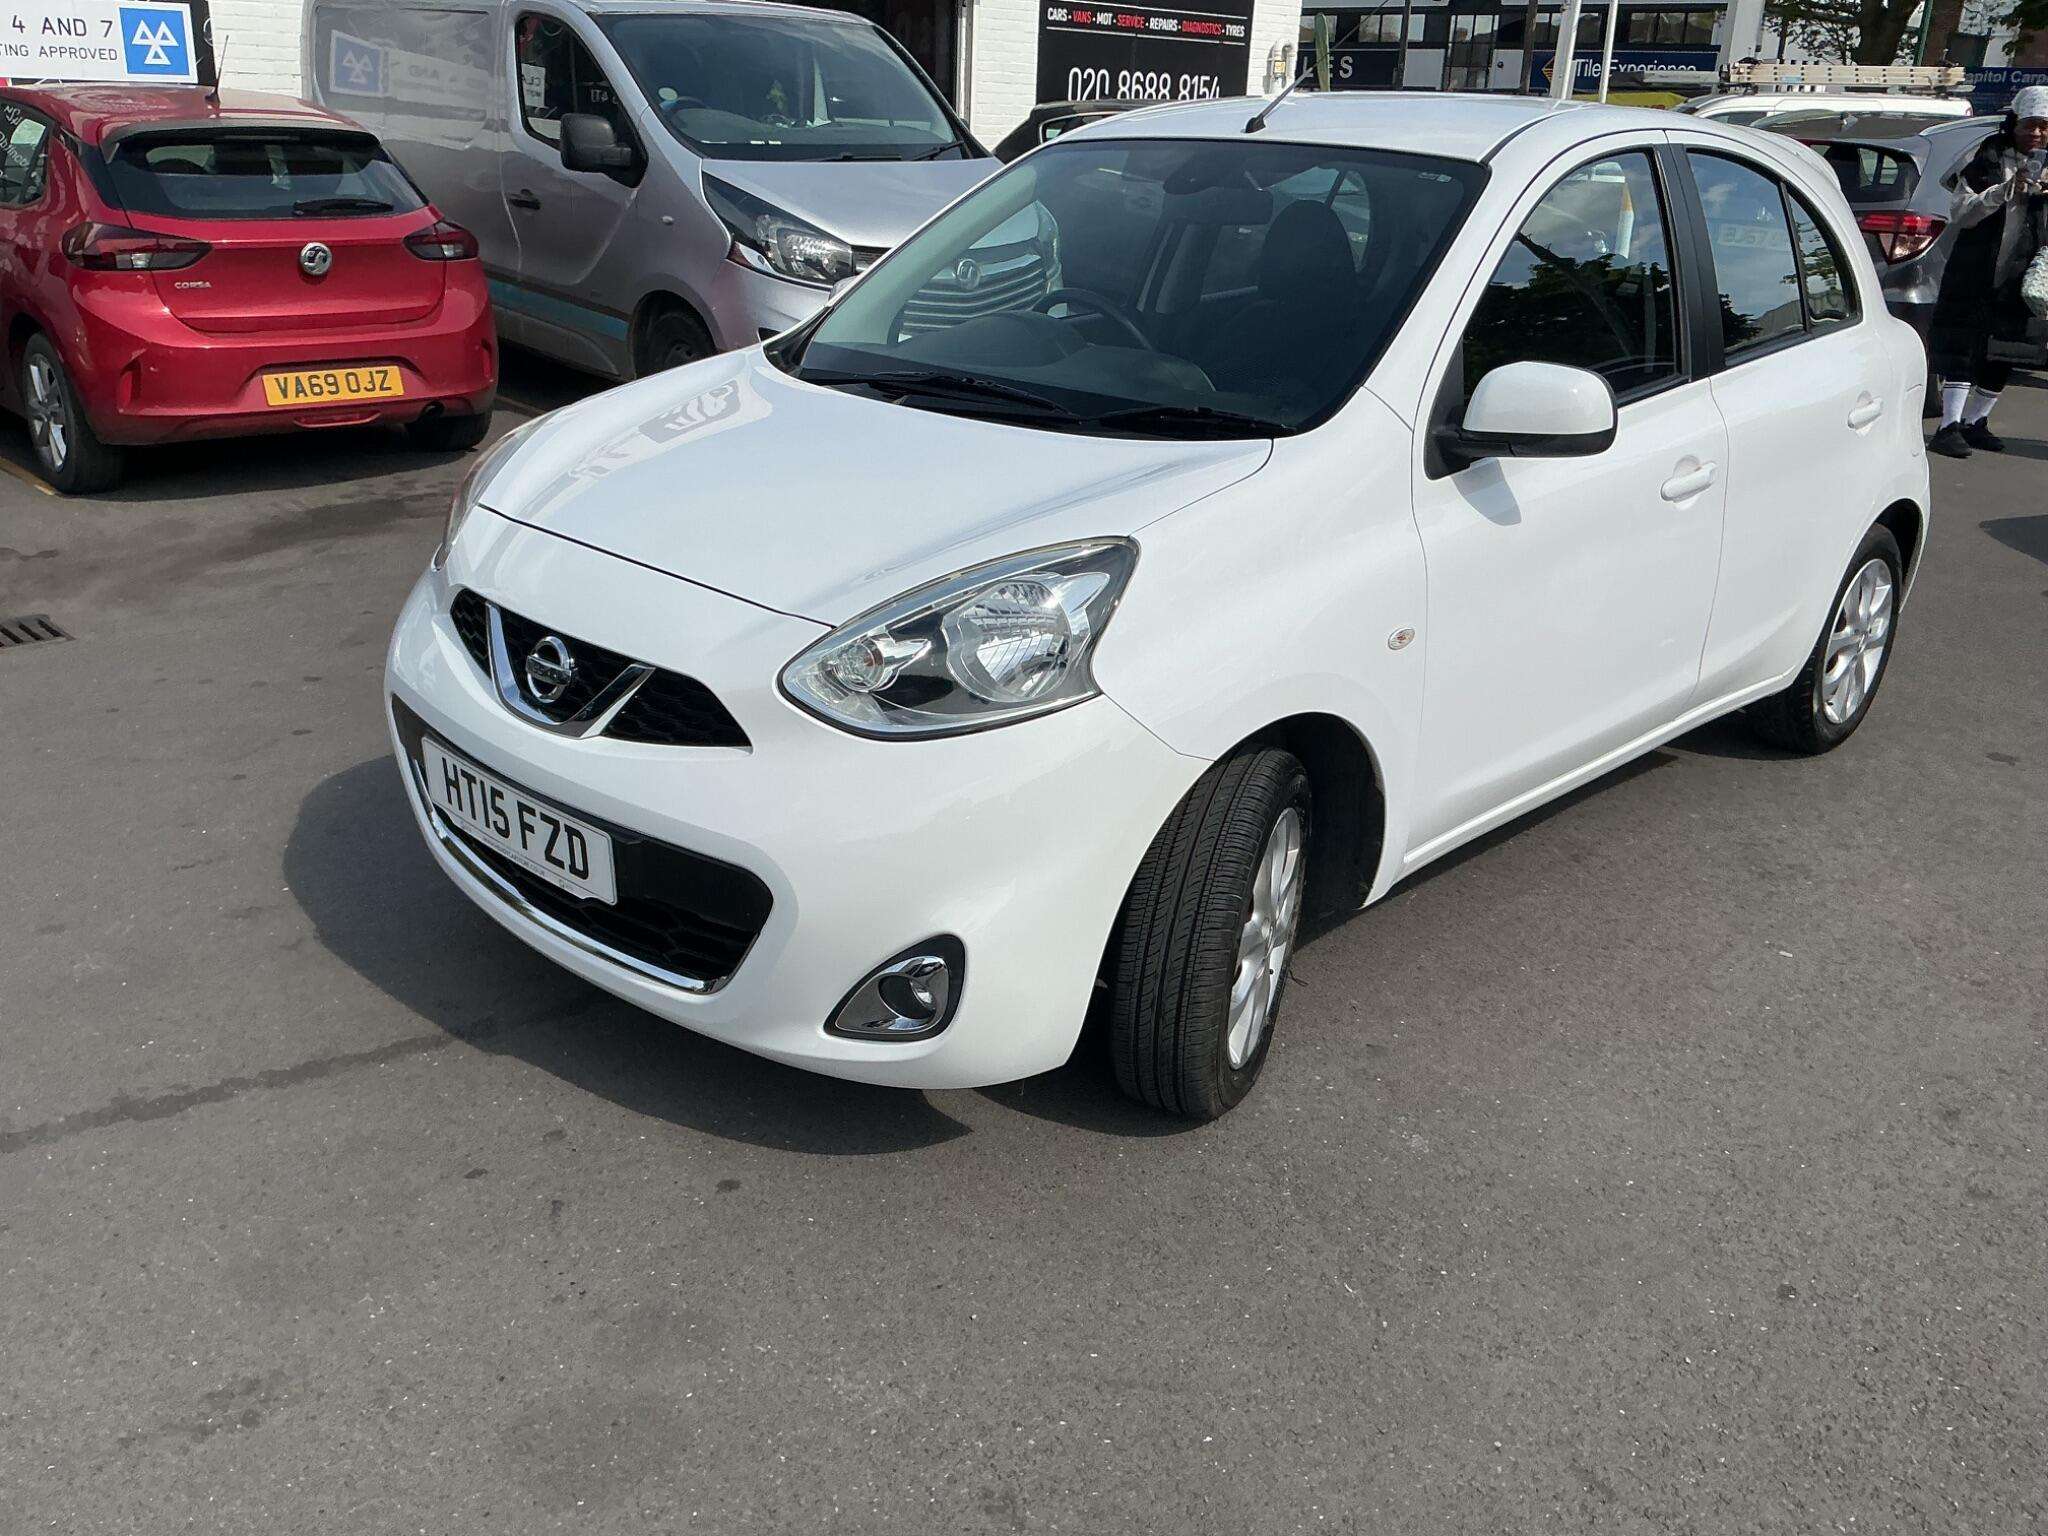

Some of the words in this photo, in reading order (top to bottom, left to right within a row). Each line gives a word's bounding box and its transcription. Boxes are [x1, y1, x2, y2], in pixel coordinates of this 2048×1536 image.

[12, 15, 25, 34] 4
[41, 17, 87, 37] AND
[100, 20, 113, 38] 7
[1047, 7, 1068, 22] CARS
[1072, 10, 1092, 24] VANS
[1096, 12, 1113, 26] MOT
[1117, 14, 1145, 29] SERVICE
[1149, 17, 1178, 31] REPAIRS
[1182, 20, 1222, 35] DIAGNOSTICS
[1225, 24, 1245, 37] TYRES
[39, 45, 118, 60] APPROVED
[1574, 59, 1602, 77] Tile
[1964, 70, 2006, 84] apitol
[2011, 70, 2048, 86] Carp
[1068, 67, 1109, 101] 020
[1116, 70, 1171, 100] 8688
[1178, 73, 1220, 101] 8154
[274, 373, 339, 399] VA69
[345, 369, 392, 393] OJZ
[442, 757, 511, 839] HT15
[516, 800, 589, 880] FZD
